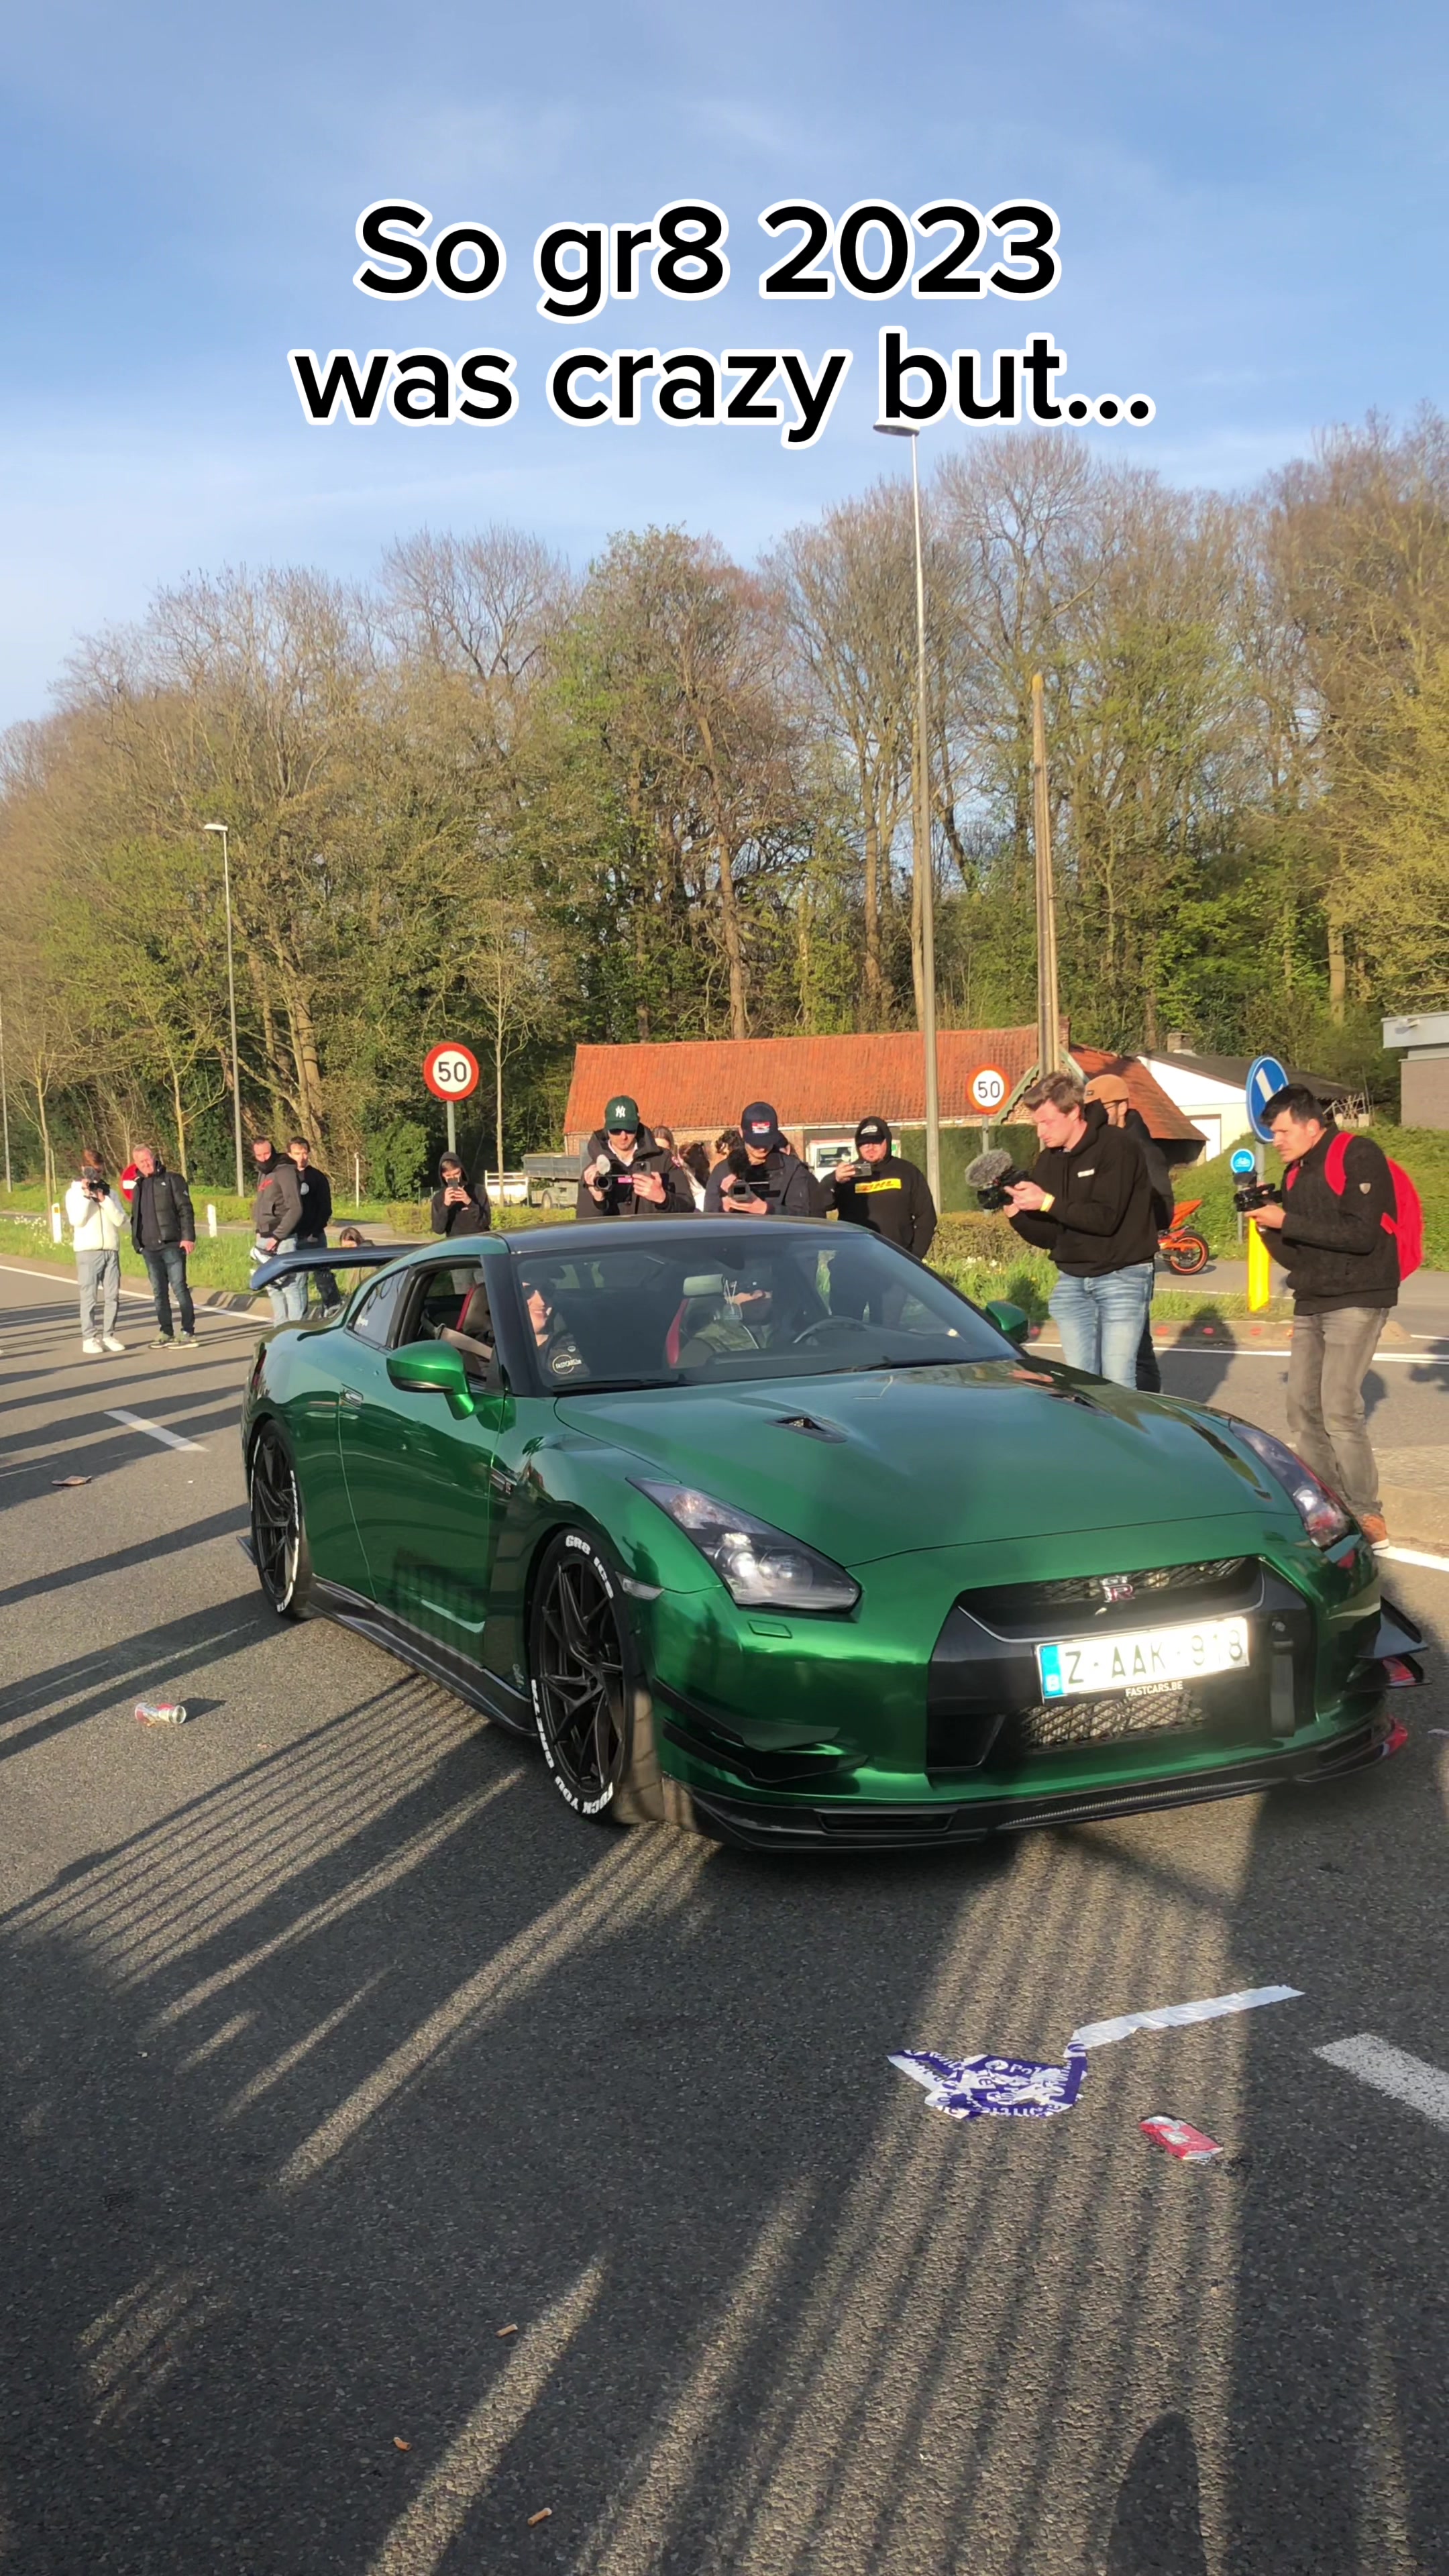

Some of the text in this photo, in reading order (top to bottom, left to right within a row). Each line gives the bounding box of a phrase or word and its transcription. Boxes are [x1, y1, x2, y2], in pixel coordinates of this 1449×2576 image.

[438, 1061, 467, 1082] 50
[978, 1081, 1000, 1098] 50
[565, 1535, 591, 1555] GR8
[1125, 1680, 1183, 1698] FASTCARS.BE
[555, 1776, 580, 1811] YOU
[582, 1782, 614, 1814] FUCK
